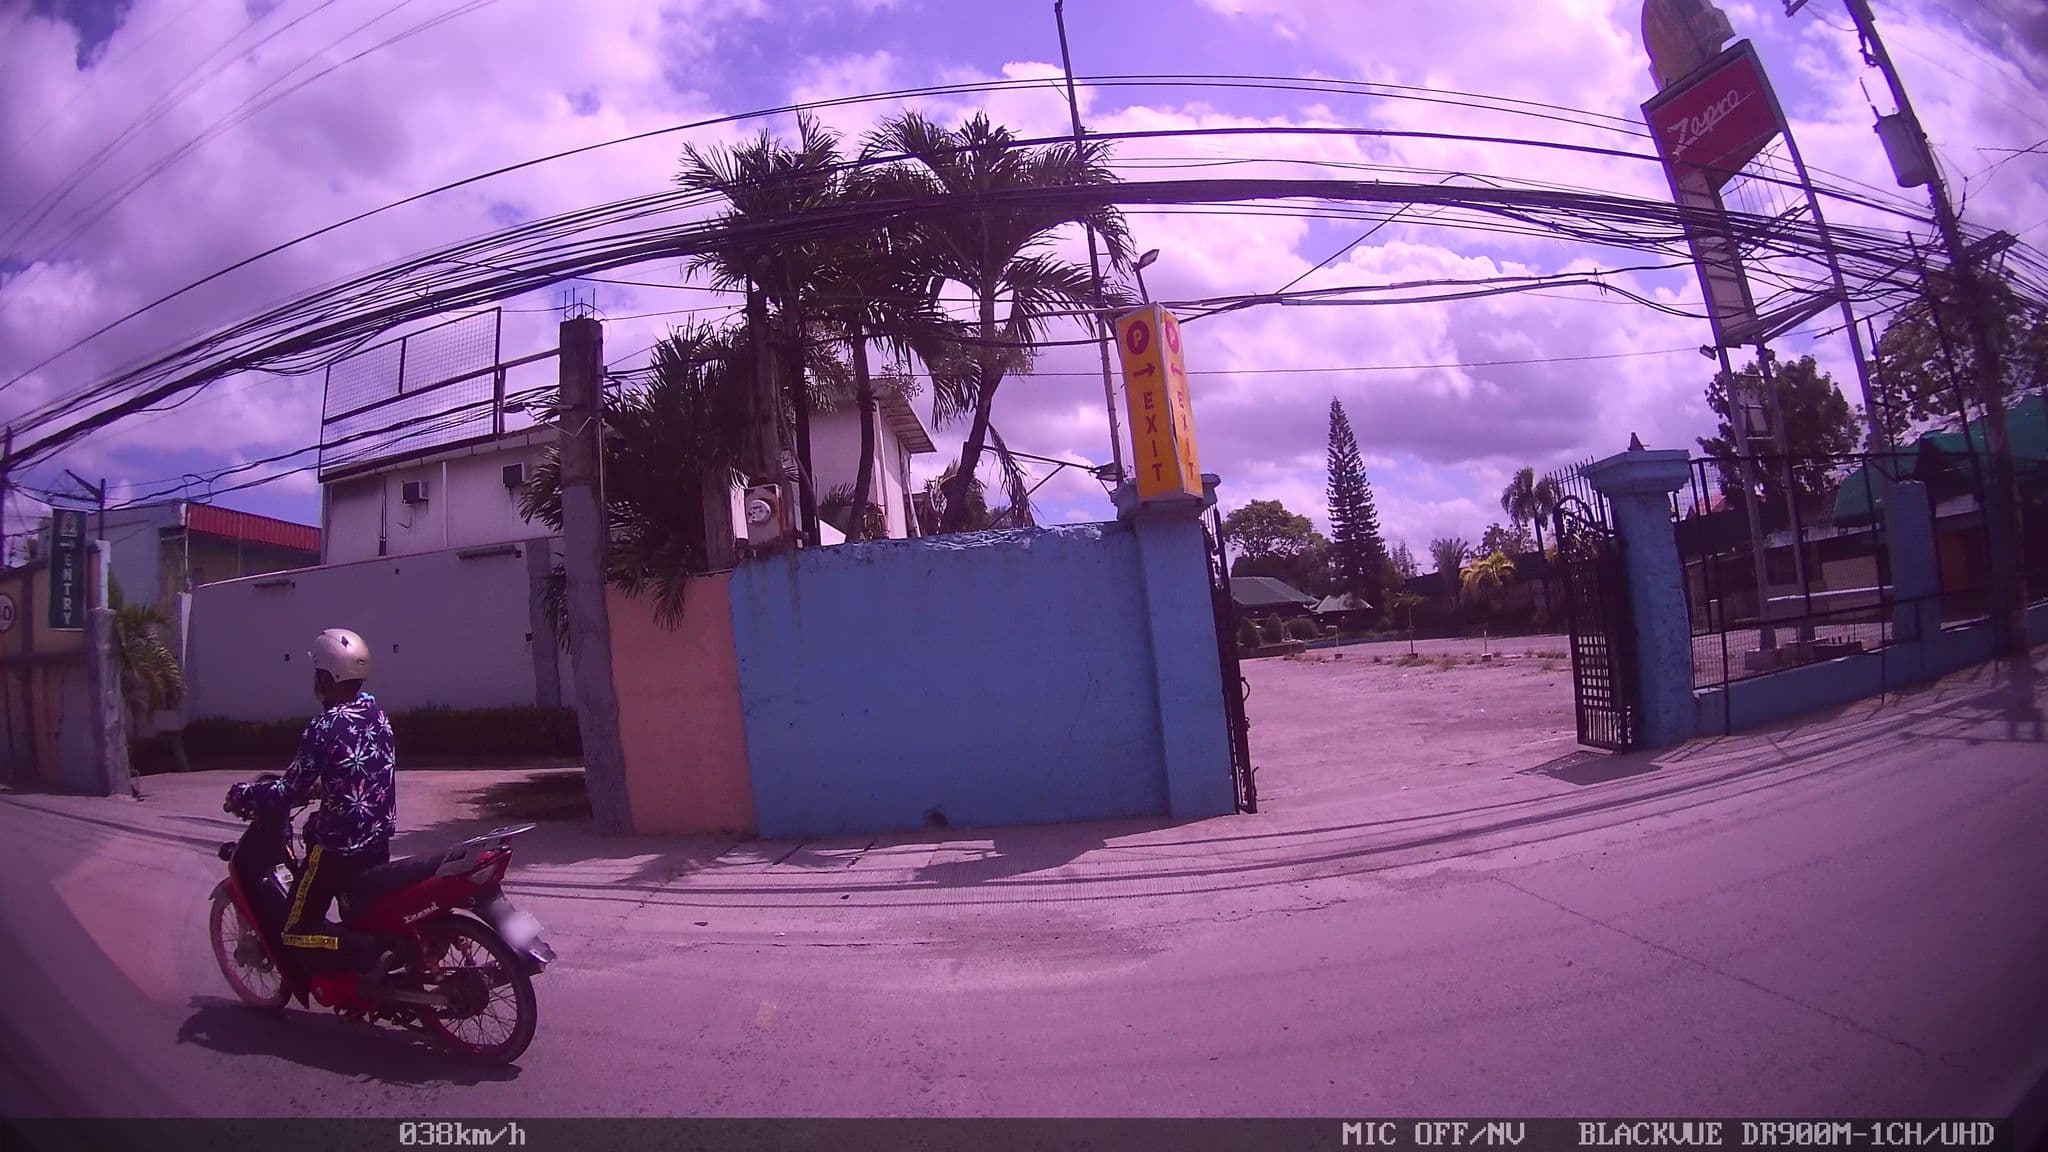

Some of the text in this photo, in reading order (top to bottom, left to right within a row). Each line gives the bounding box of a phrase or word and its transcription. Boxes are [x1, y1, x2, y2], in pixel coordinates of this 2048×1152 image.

[1667, 90, 1754, 163] Zapro
[1143, 391, 1162, 482] EXIT
[1176, 390, 1194, 481] EXIT
[0, 605, 12, 620] 0
[63, 553, 73, 625] ENTRY
